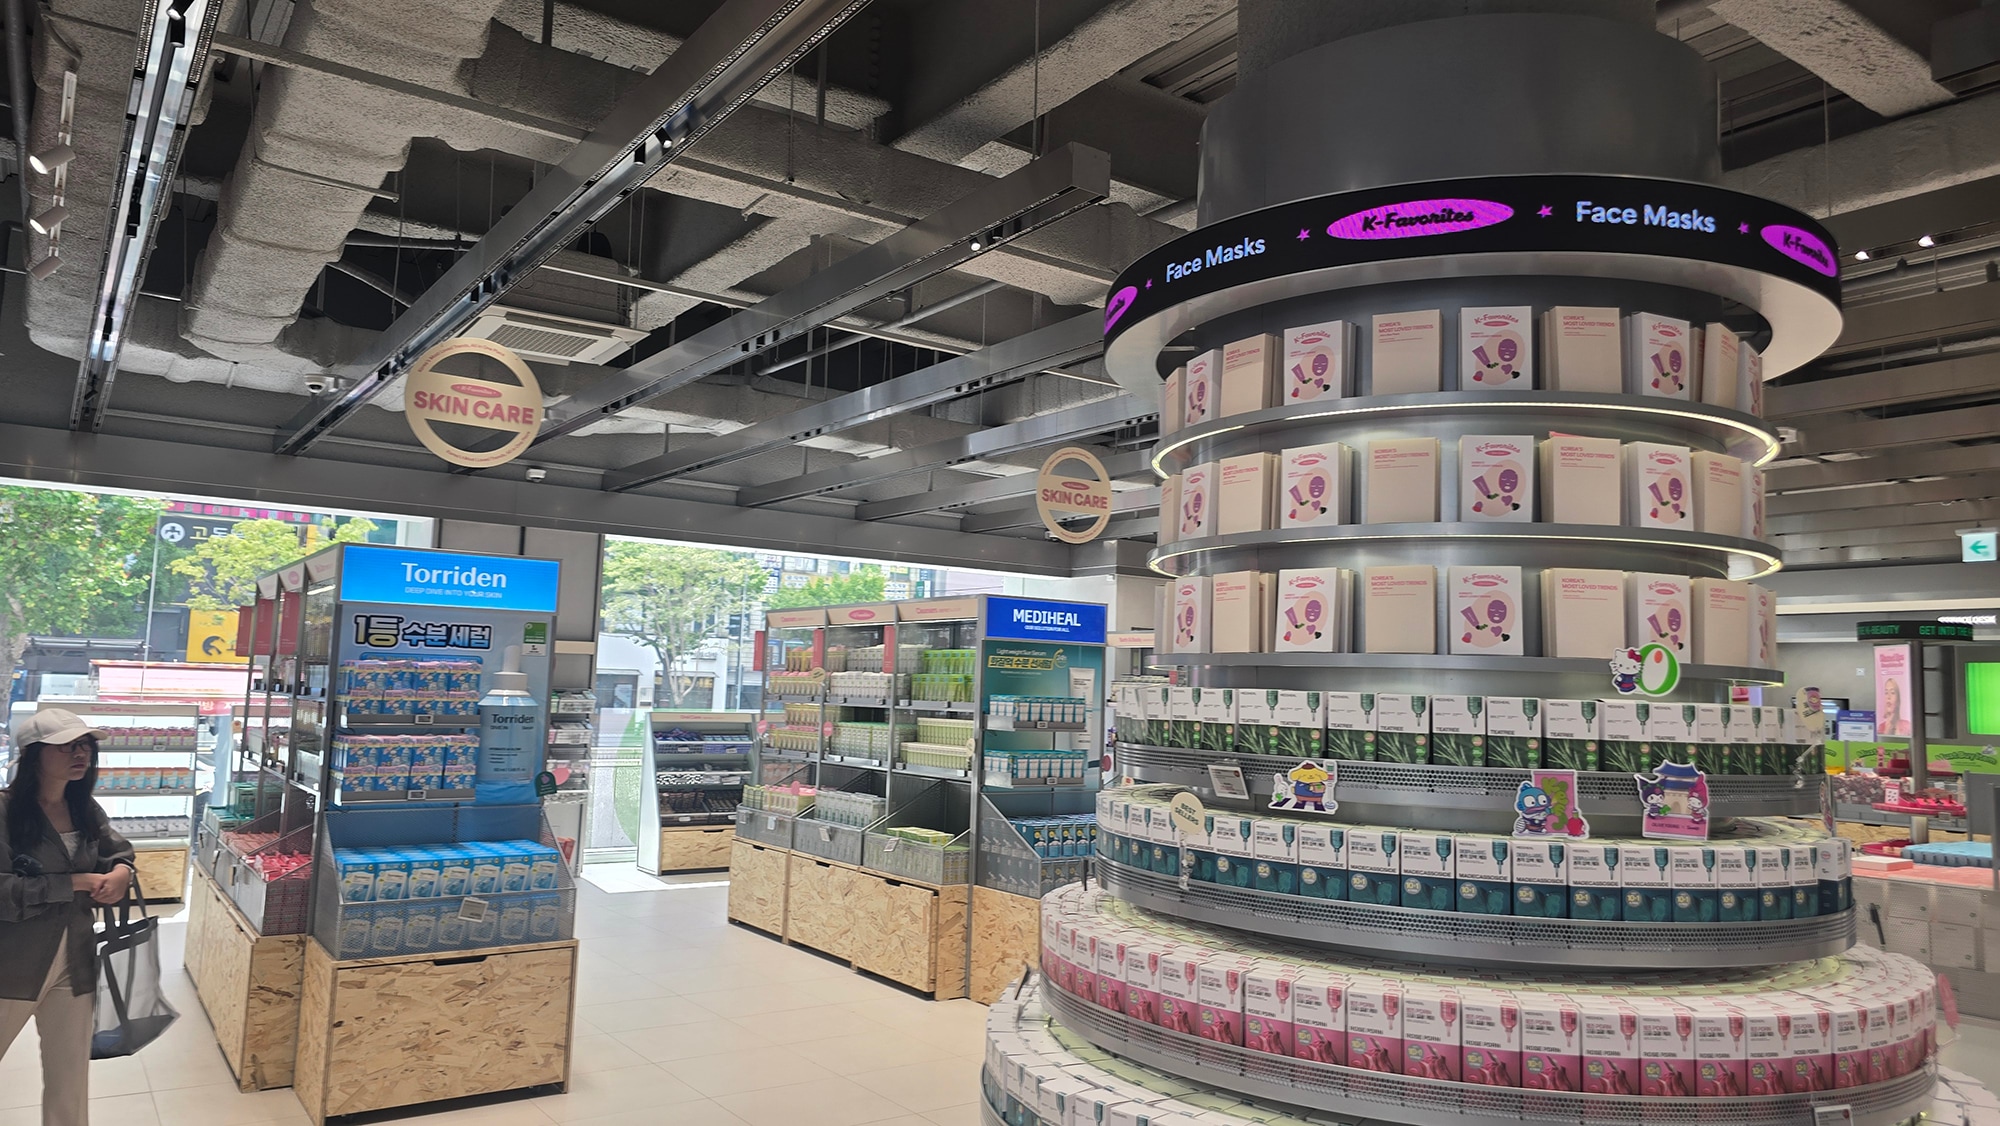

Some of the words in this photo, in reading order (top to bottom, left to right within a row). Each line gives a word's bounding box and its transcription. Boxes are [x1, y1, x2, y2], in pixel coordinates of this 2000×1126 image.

[1362, 208, 1474, 232] K-Favorites
[1576, 201, 1638, 225] Face
[1644, 204, 1716, 233] Masks
[1165, 258, 1202, 282] Face
[1206, 237, 1266, 267] Masks
[414, 391, 468, 416] SKIN
[473, 400, 534, 425] CARE
[1042, 488, 1073, 504] SKIN
[1074, 493, 1108, 509] CARE
[401, 563, 507, 588] Torriden
[1013, 609, 1081, 627] MEDIHEAL
[1919, 626, 1936, 635] GET
[1938, 626, 1955, 635] INTO
[1174, 806, 1200, 826] SELLERS
[1181, 802, 1197, 814] BEST
